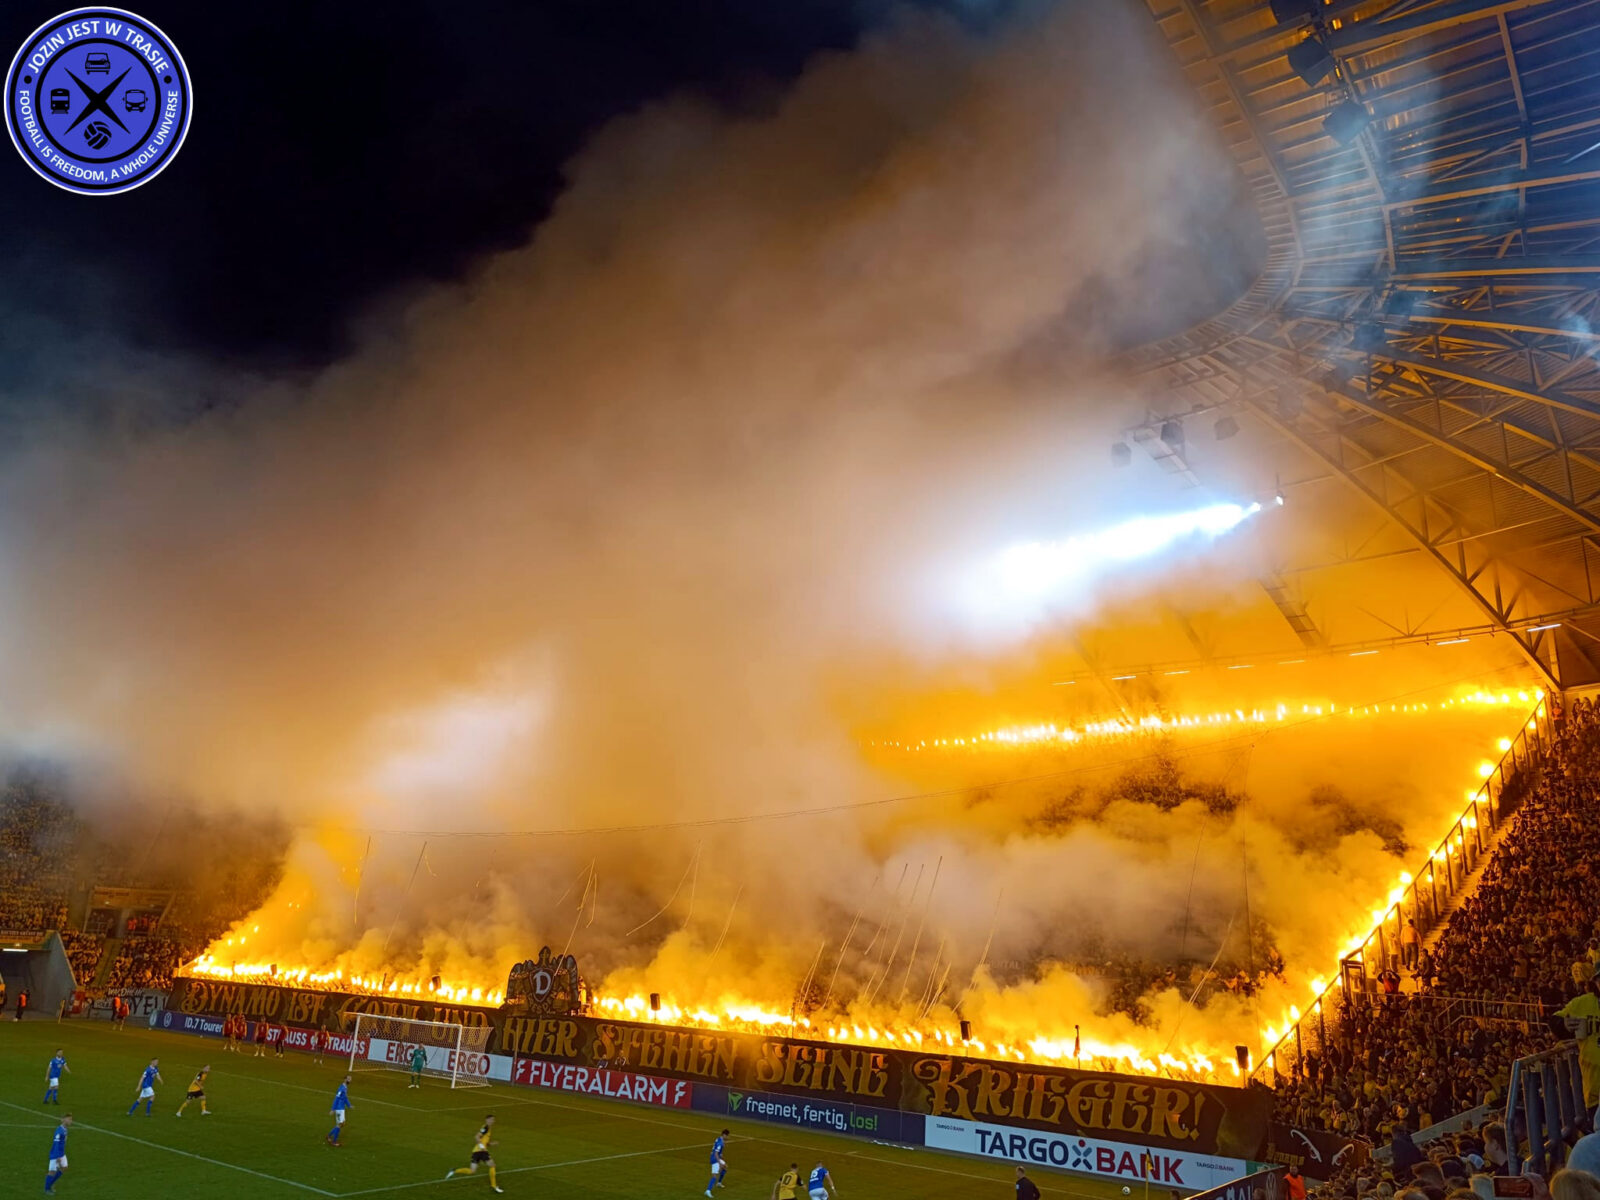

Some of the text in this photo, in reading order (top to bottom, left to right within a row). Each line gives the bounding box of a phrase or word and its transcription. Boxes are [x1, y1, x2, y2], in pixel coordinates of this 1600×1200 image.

[185, 1017, 223, 1033] ID.7 Tourer
[180, 981, 280, 1017] DYNAMO
[287, 991, 327, 1024] IST
[431, 1006, 488, 1046] UND
[503, 1018, 578, 1057] HIER
[592, 1023, 738, 1079] STEHEN
[756, 1042, 889, 1097] SEINE
[912, 1058, 1206, 1141] KRIEGER!
[386, 1042, 416, 1063] ERG
[447, 1051, 491, 1075] ERGO
[529, 1061, 669, 1105] FLYERALARM
[746, 1097, 878, 1131] freenet, fertig, los!
